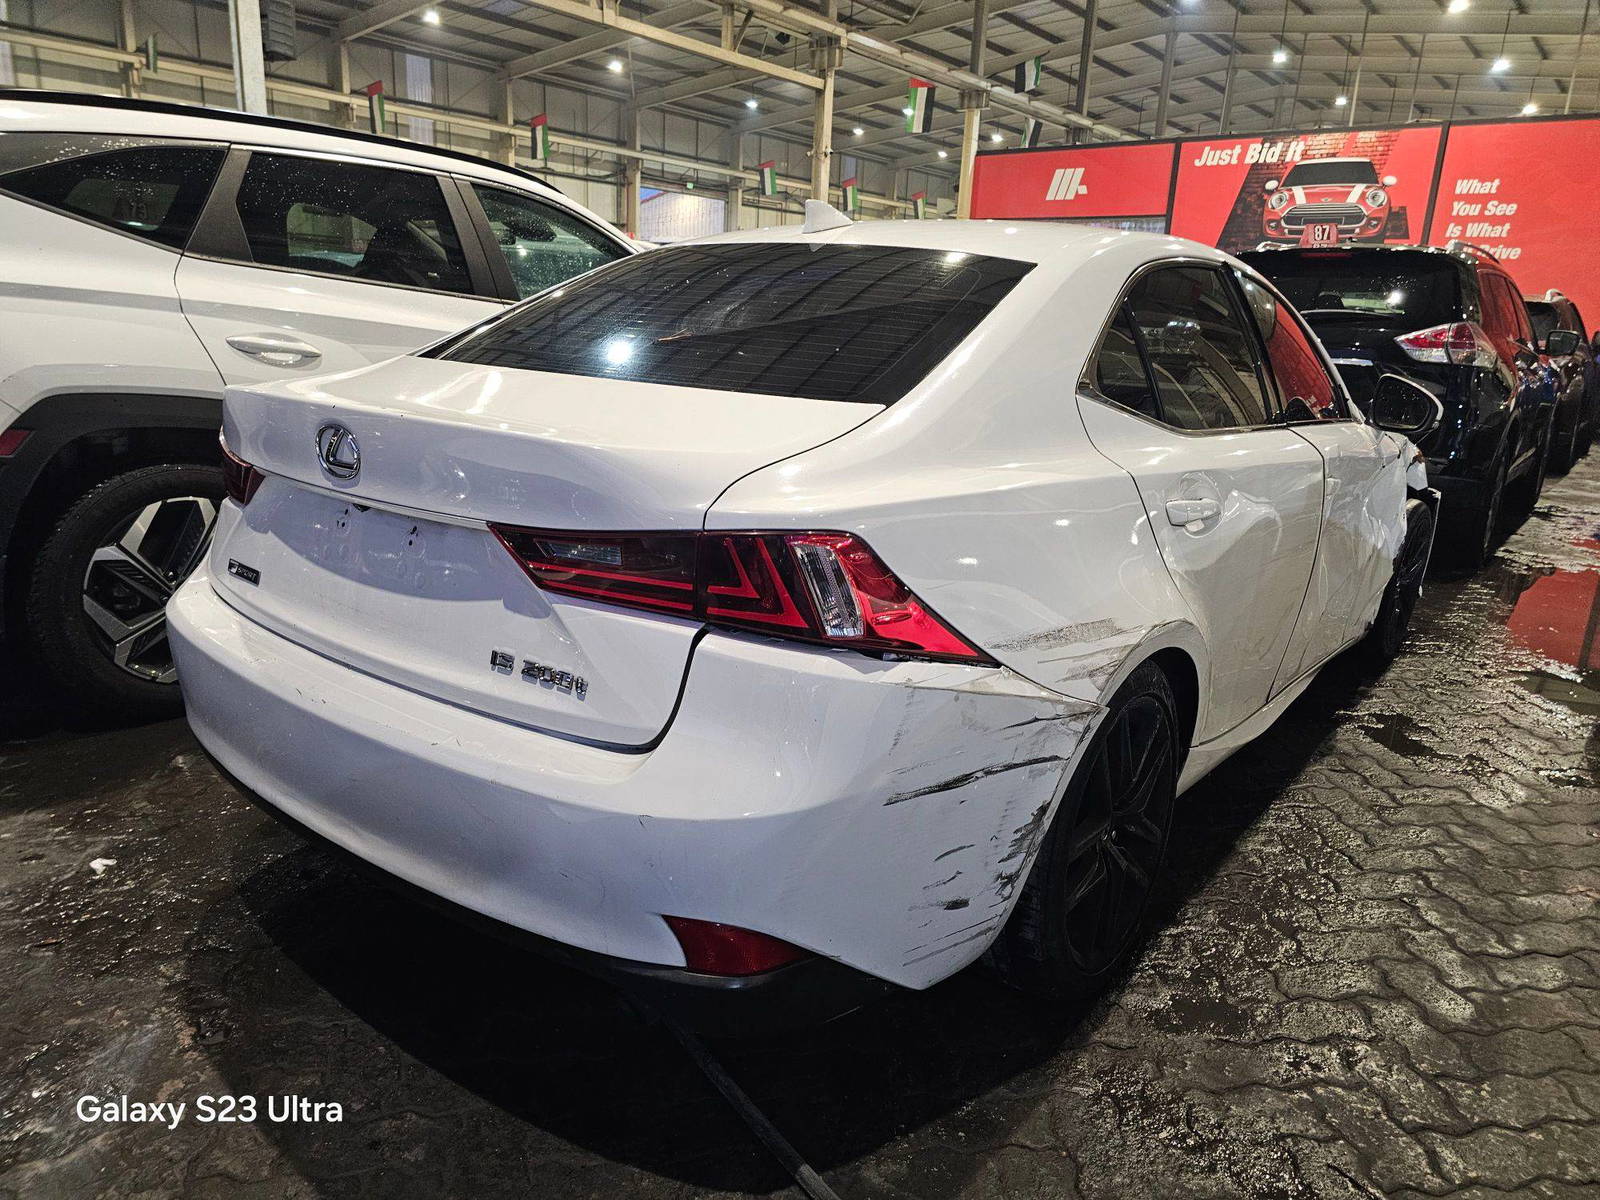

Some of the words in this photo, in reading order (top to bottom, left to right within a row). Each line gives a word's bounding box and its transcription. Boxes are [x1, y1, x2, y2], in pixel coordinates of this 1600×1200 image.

[1194, 144, 1241, 167] Just
[1244, 142, 1284, 165] Bid
[1284, 140, 1306, 163] It
[1454, 178, 1500, 195] What
[1451, 201, 1482, 217] You
[1484, 200, 1518, 216] See
[1313, 225, 1331, 241] 87
[1445, 222, 1463, 238] Is
[1465, 222, 1511, 238] What
